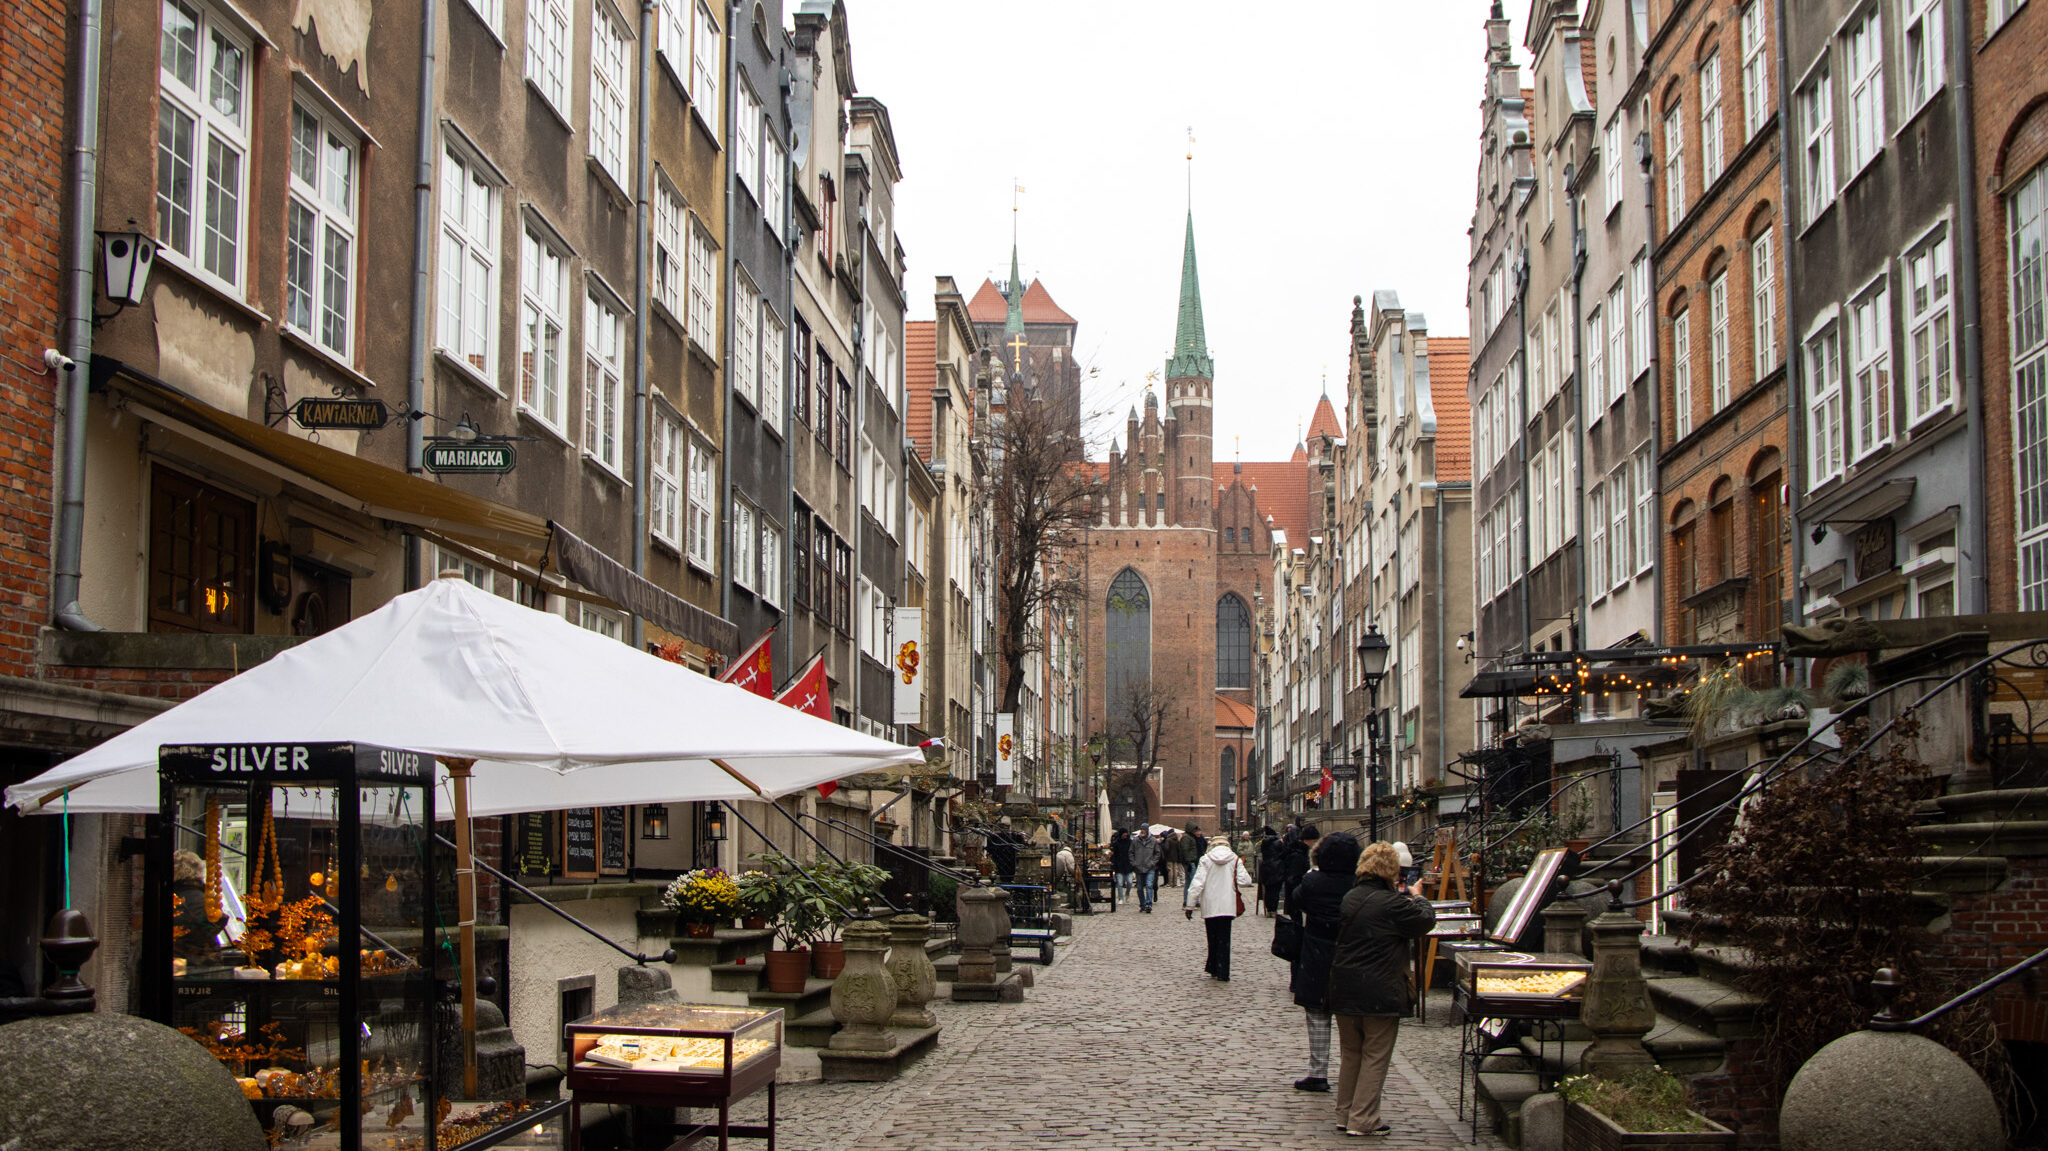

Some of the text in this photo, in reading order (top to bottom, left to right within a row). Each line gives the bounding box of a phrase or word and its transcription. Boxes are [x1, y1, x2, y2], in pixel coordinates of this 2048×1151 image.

[435, 450, 505, 467] MARIACKA
[210, 746, 310, 773] SILVER
[380, 750, 420, 777] SILVER
